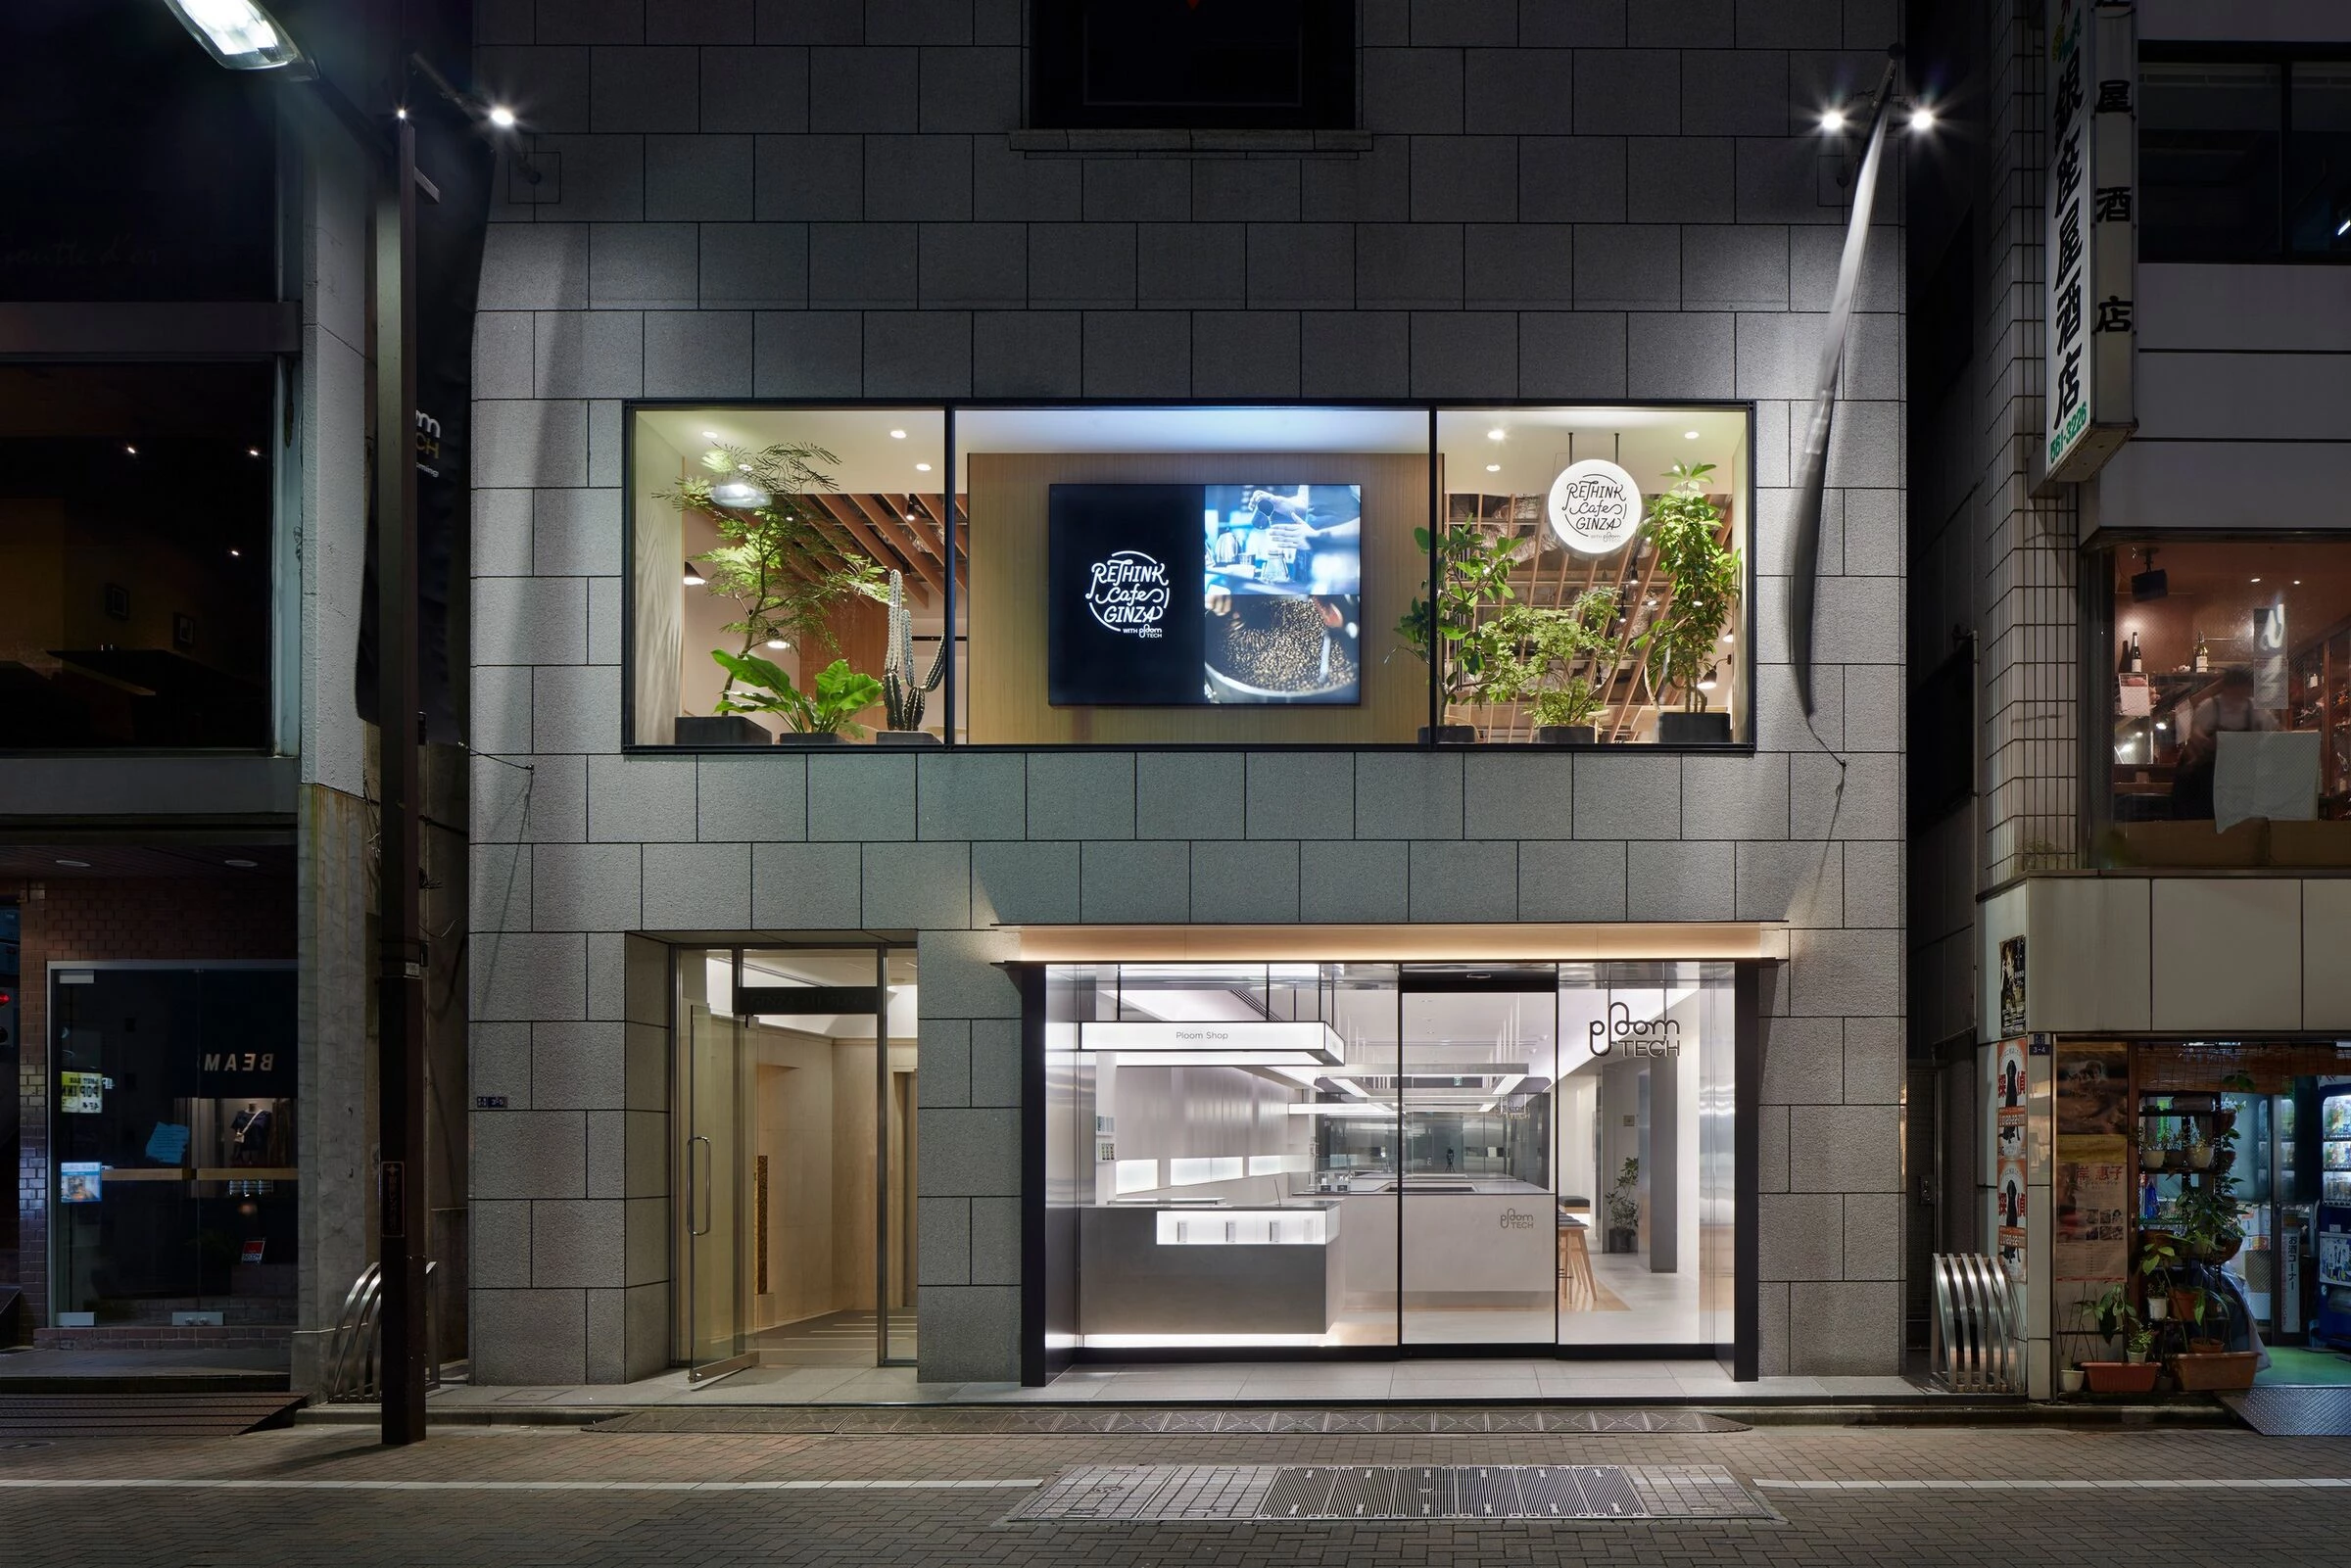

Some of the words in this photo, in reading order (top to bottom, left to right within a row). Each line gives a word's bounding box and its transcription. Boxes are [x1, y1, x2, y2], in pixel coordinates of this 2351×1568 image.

[2094, 0, 2134, 334] 屋酒店
[1576, 517, 1622, 530] GINZA
[1104, 606, 1163, 623] GINZA
[1206, 1031, 1229, 1040] Shop
[1618, 1039, 1680, 1057] TECH
[2288, 1236, 2298, 1290] お酒コーナー
